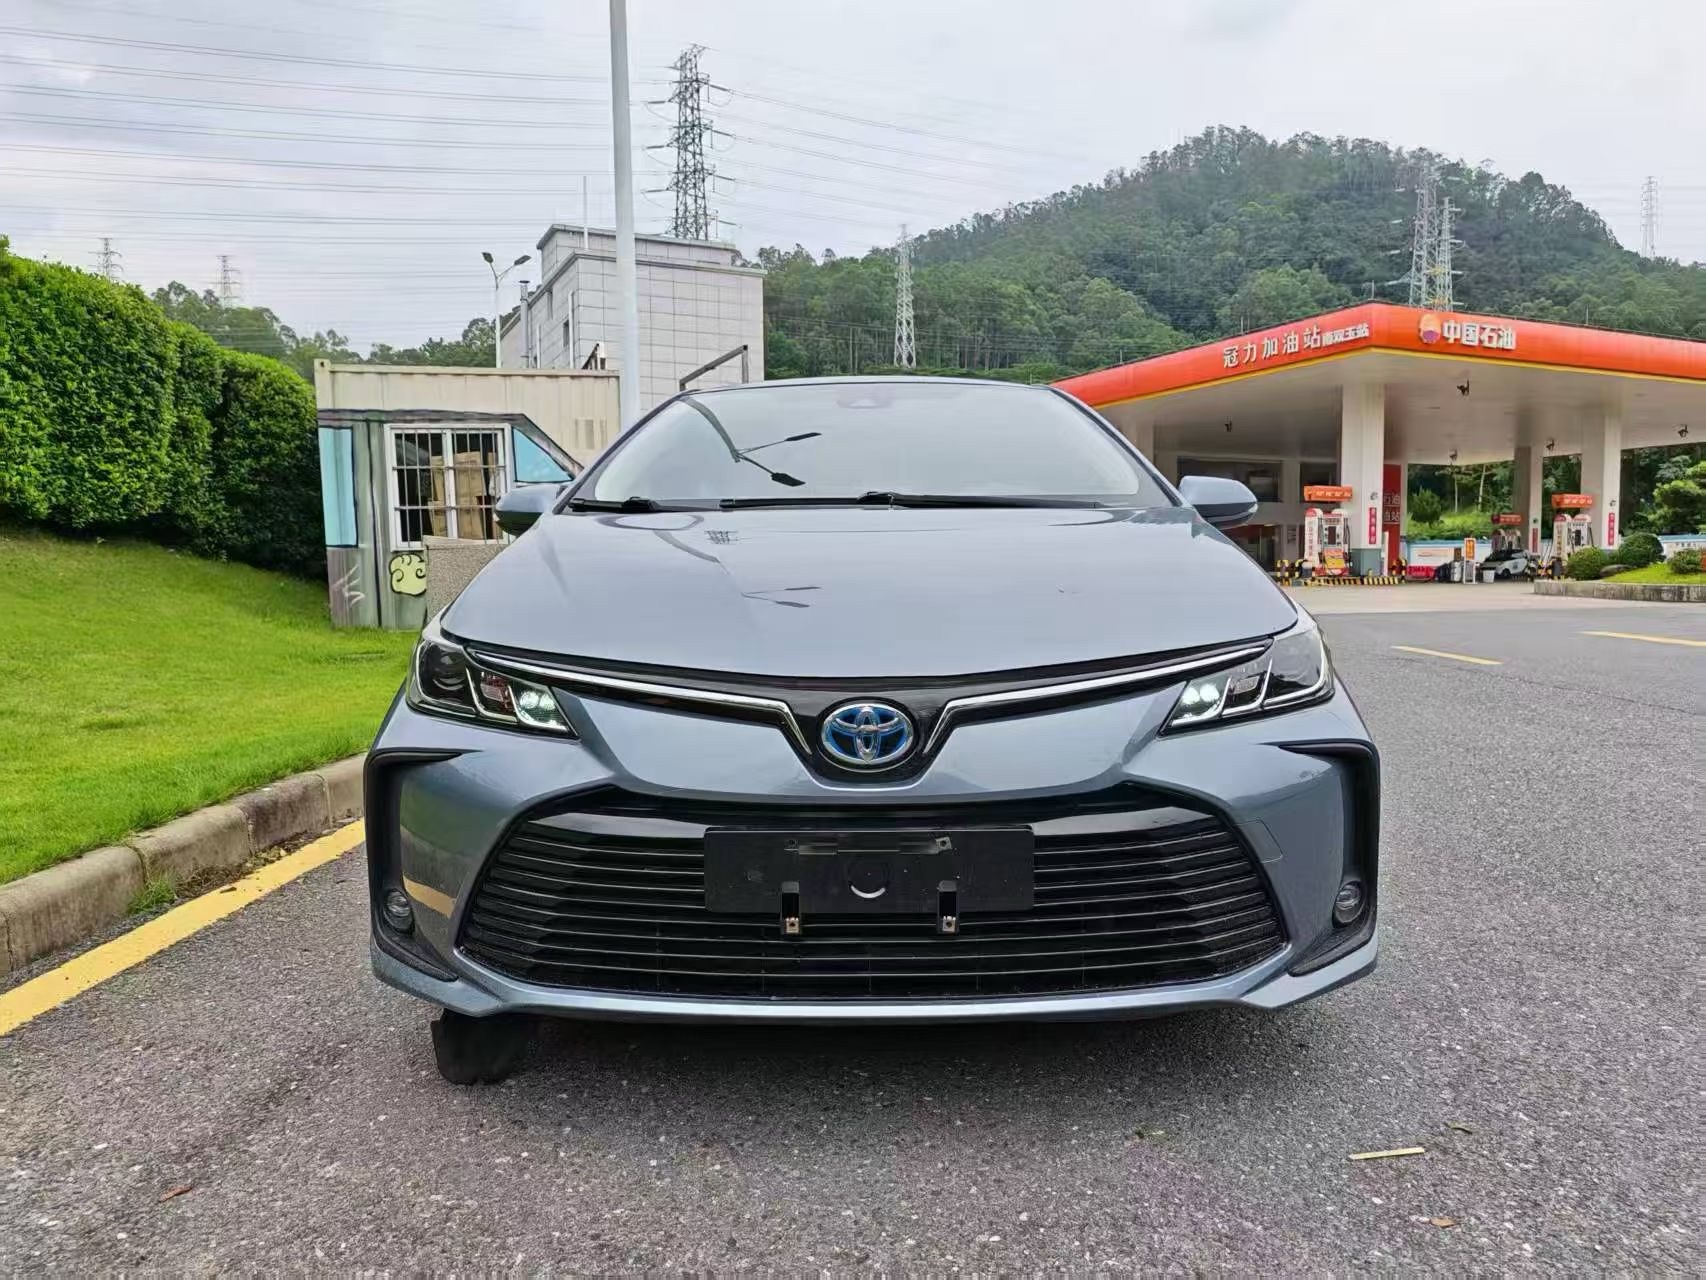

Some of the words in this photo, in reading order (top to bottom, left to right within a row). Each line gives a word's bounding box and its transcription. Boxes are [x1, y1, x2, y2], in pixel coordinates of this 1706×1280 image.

[1223, 323, 1321, 368] 冠力加油站
[1442, 319, 1517, 350] 中国石油
